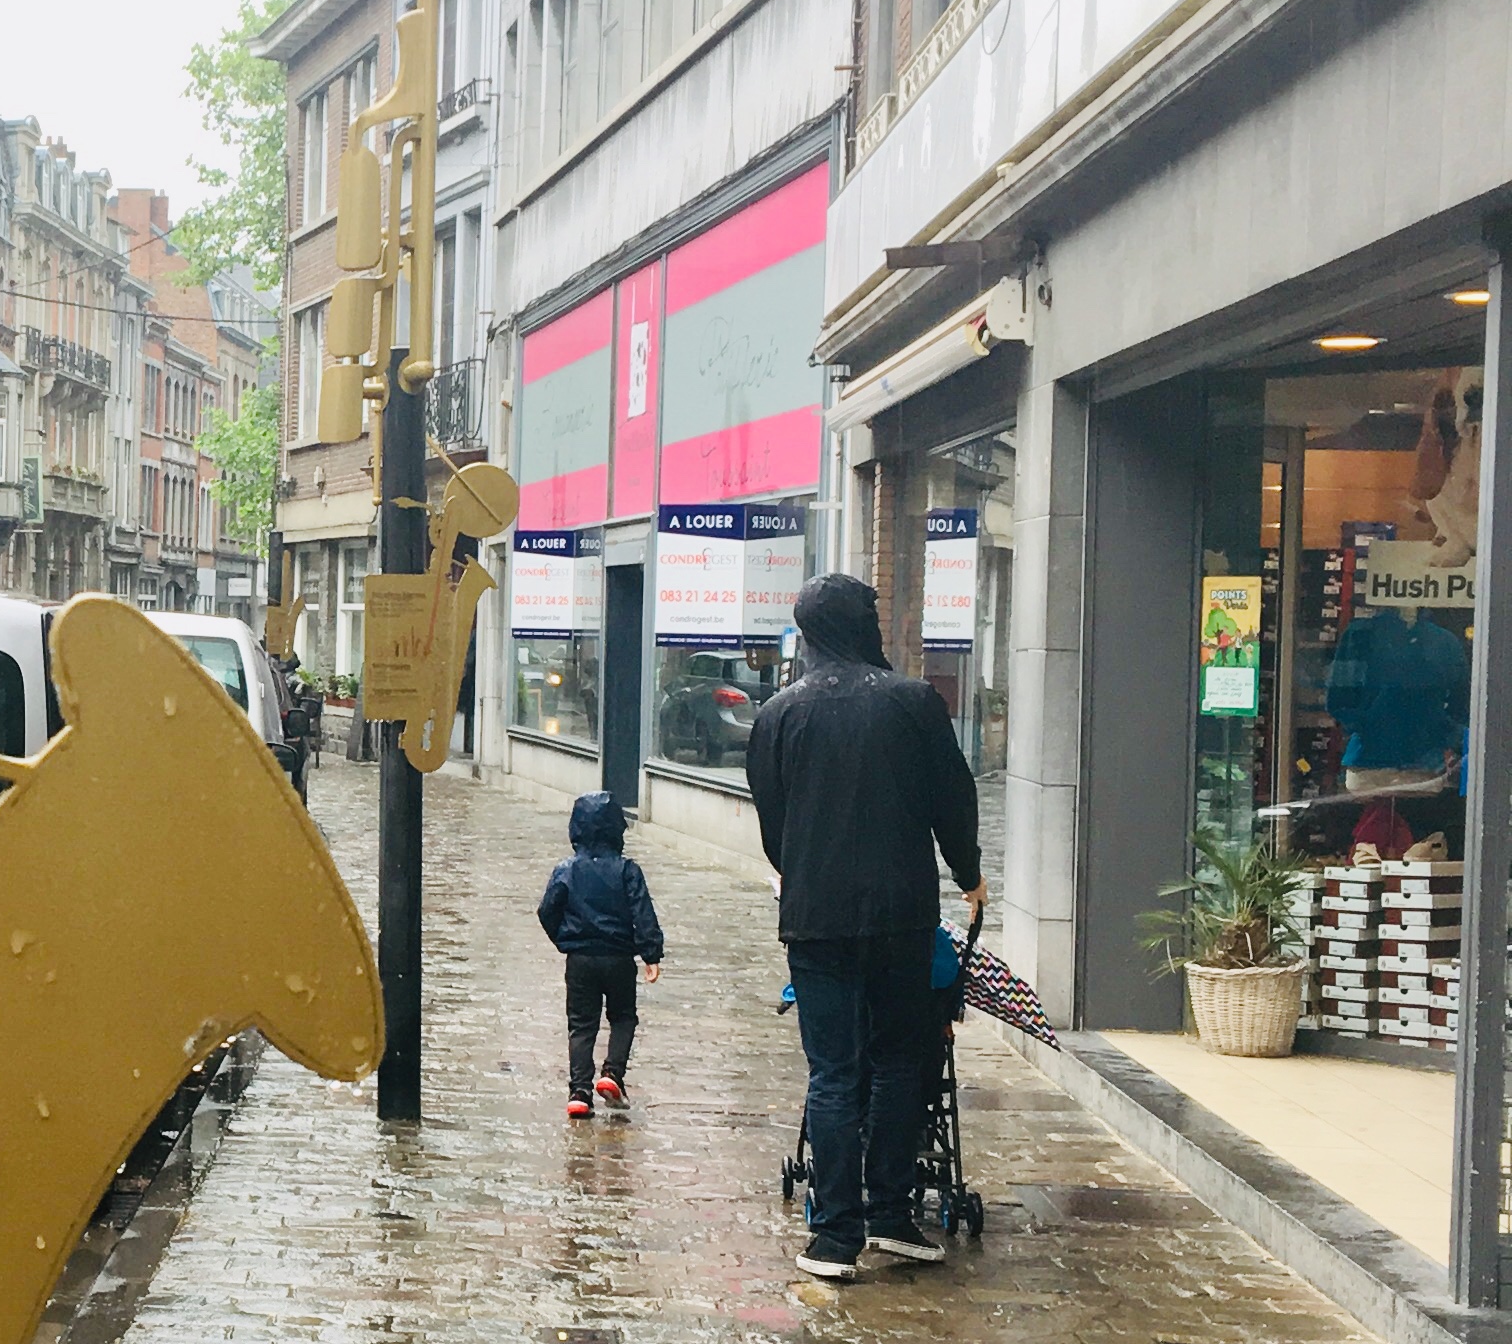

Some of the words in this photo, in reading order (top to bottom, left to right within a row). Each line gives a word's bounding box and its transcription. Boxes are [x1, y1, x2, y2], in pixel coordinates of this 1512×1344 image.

[669, 516, 681, 529] A
[686, 515, 734, 529] LOUER
[521, 538, 529, 549] A
[532, 538, 566, 549] LOUER
[1372, 573, 1438, 598] Hush
[532, 596, 542, 605] 21
[660, 590, 682, 603] 083
[685, 590, 699, 603] 21
[703, 590, 718, 603] 24
[721, 590, 737, 603] 25
[1211, 590, 1247, 600] POINTS
